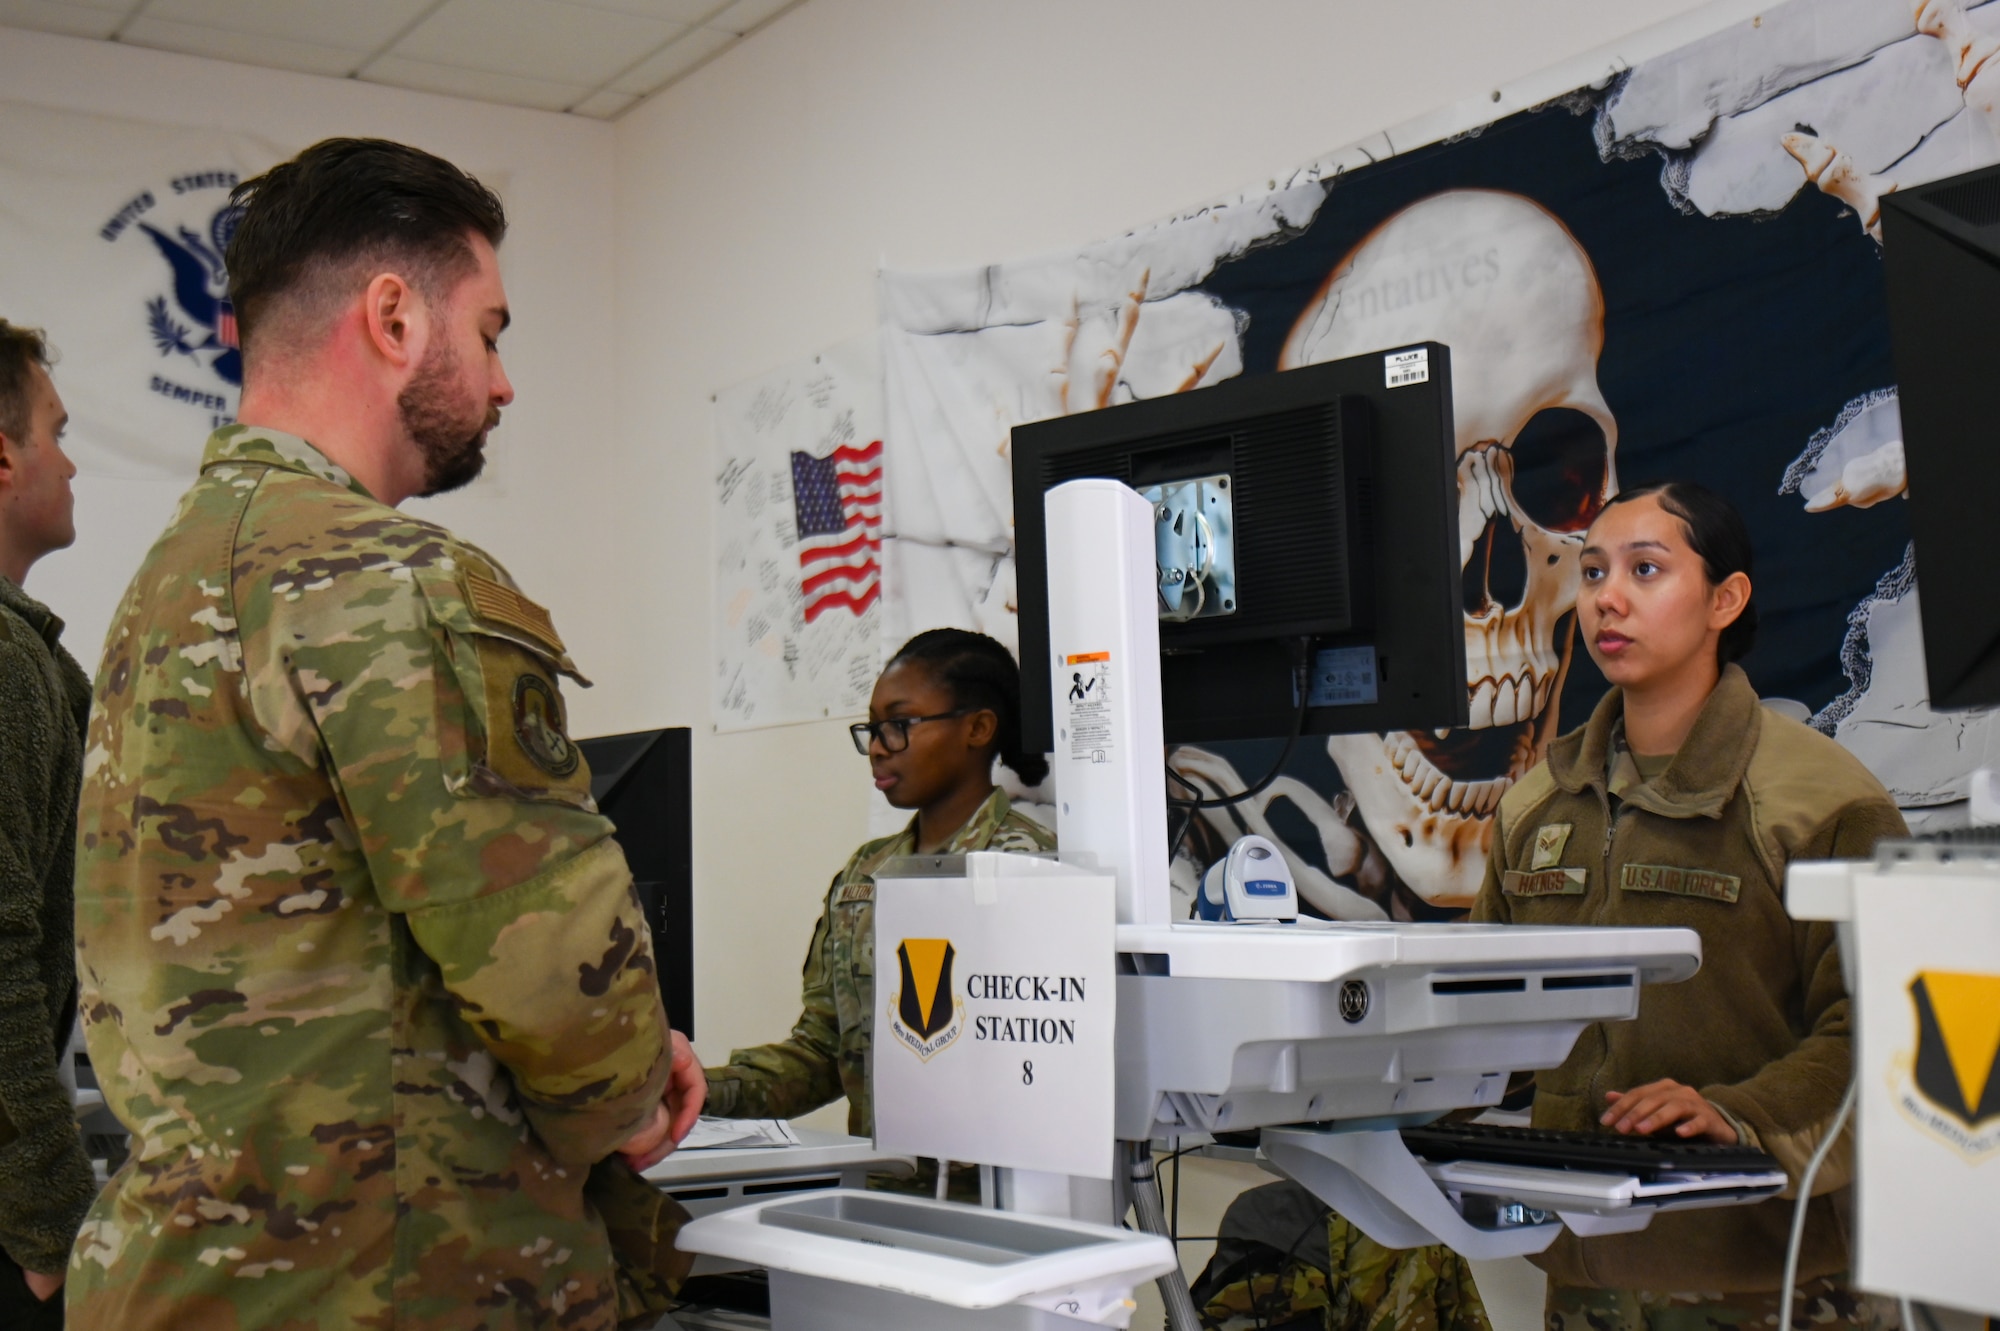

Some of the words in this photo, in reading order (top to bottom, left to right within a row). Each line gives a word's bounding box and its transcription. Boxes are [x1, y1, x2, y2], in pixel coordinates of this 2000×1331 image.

[99, 190, 157, 242] UNITED
[172, 171, 239, 196] STATES
[150, 374, 226, 412] SEMPER
[1655, 869, 1681, 891] AIR
[1683, 871, 1733, 898] FORCE
[967, 974, 1087, 1003] CHECK-IN
[905, 1032, 936, 1057] MEDICAL
[935, 1025, 957, 1048] GROUP
[975, 1015, 1076, 1045] STATION
[1022, 1060, 1034, 1086] 8
